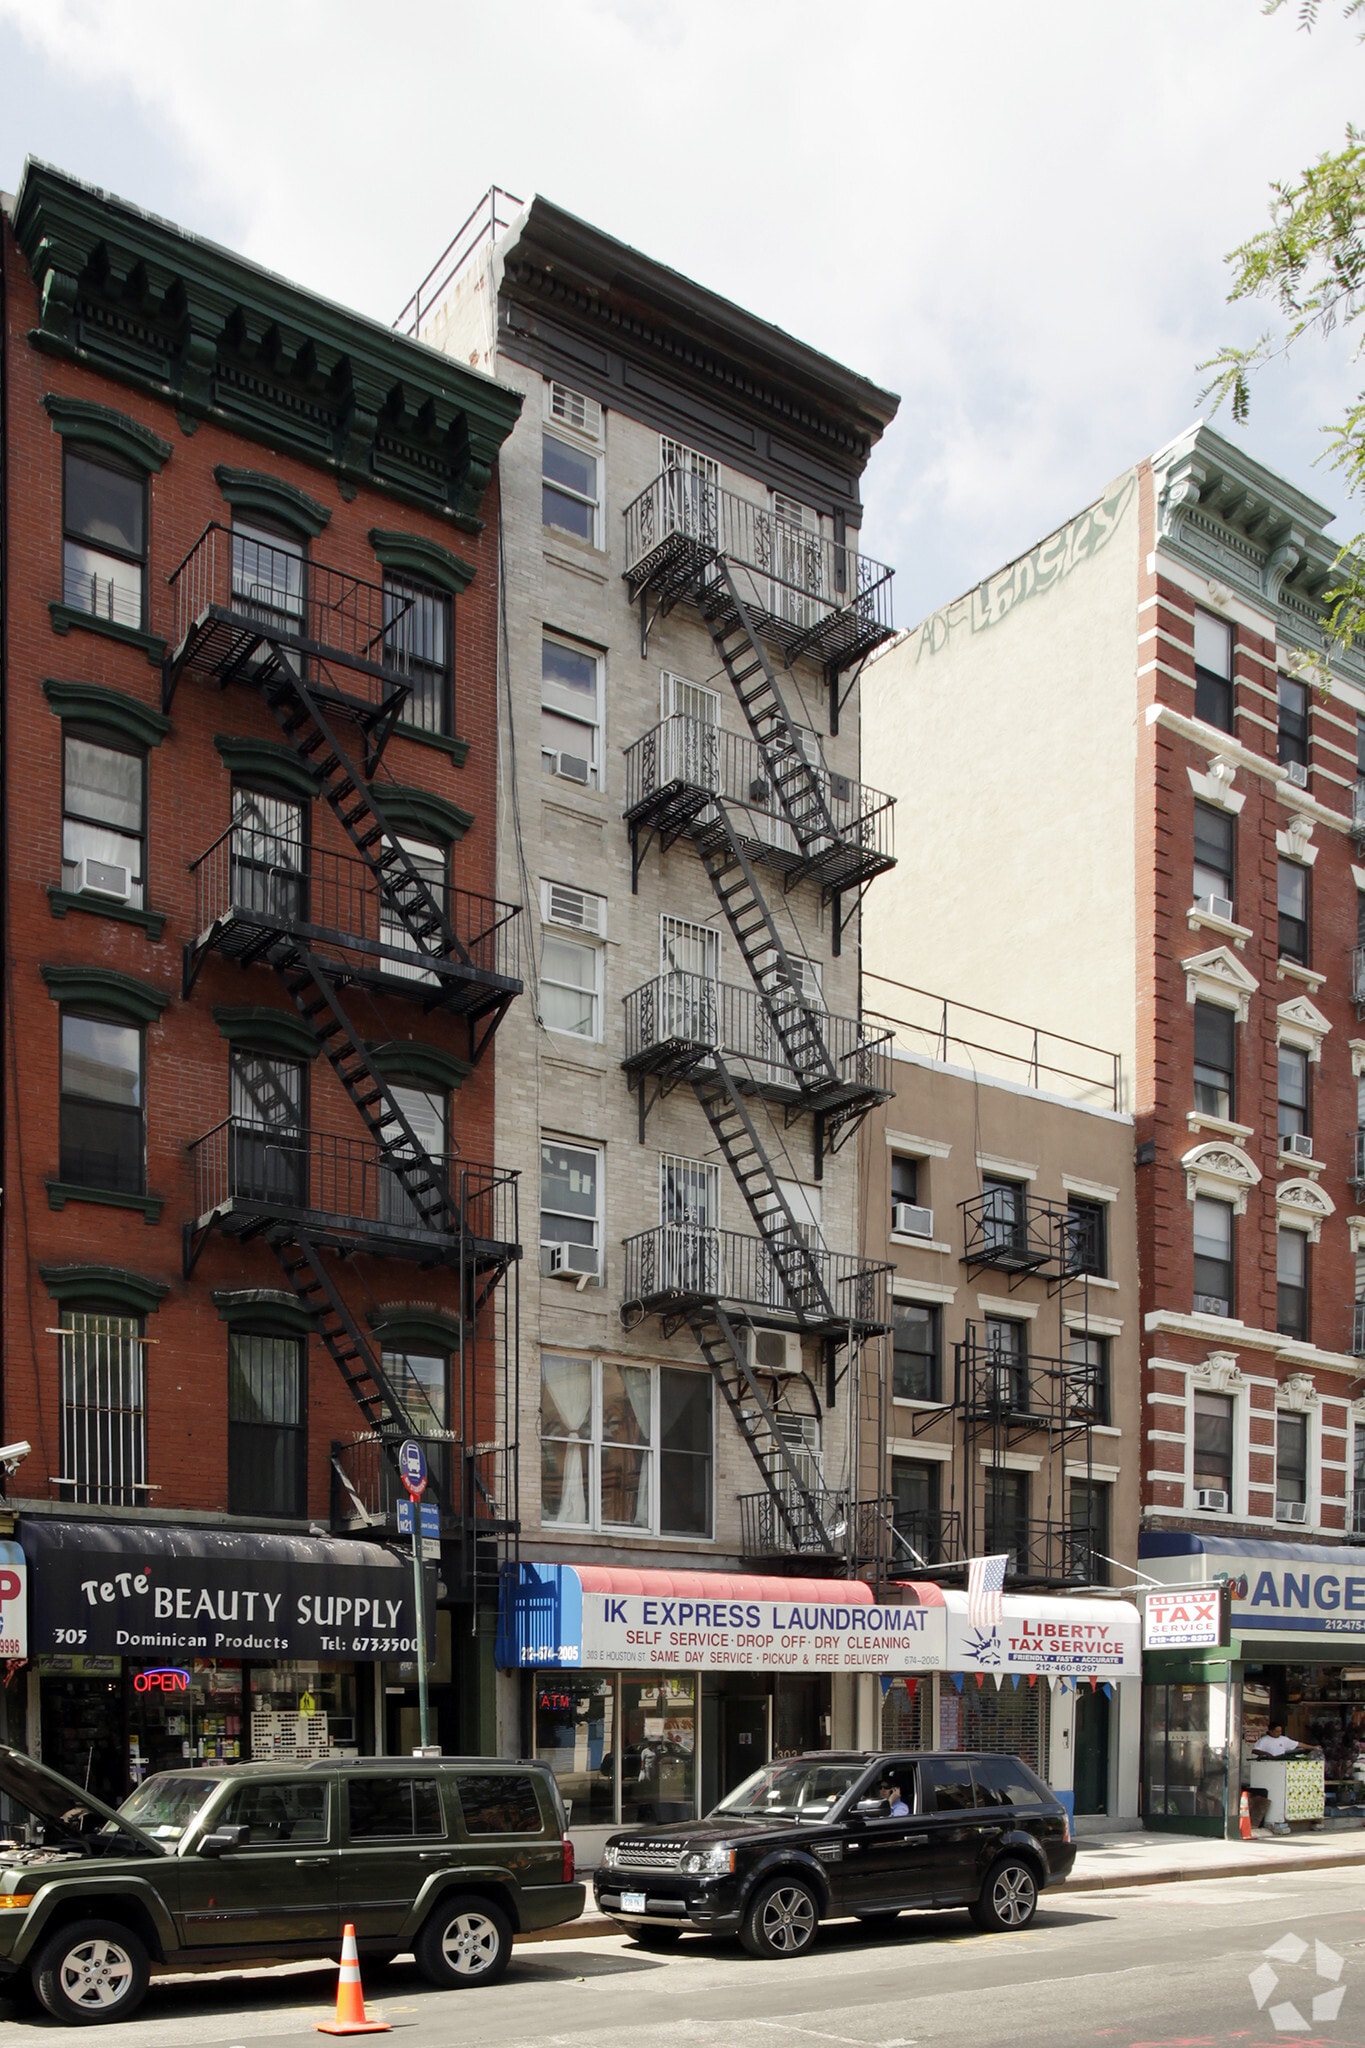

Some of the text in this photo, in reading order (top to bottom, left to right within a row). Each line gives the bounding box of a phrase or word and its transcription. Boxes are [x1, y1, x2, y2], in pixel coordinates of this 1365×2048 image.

[400, 1519, 412, 1532] M21
[1250, 1571, 1365, 1611] ANGE
[1152, 1594, 1211, 1605] LIBERTY
[154, 1587, 282, 1622] BEAUTY
[297, 1594, 403, 1628] SUPPLY
[1149, 1605, 1215, 1624] TAX
[643, 1601, 761, 1629] EXPRESS
[773, 1606, 929, 1631] LAUNDROMAT
[1023, 1620, 1110, 1639] LIBERTY
[1152, 1623, 1213, 1633] SERVICE
[1325, 1619, 1365, 1631] 212-475-
[55, 1628, 87, 1645] 305
[116, 1630, 207, 1648] Dominican
[214, 1632, 289, 1650] Products
[320, 1636, 346, 1650] Tel:
[626, 1630, 911, 1649] SELF SERVICE DROP OFF DRY CLEANING
[1008, 1638, 1124, 1654] TAX SERVICE
[521, 1646, 579, 1661] 212-674-2005
[586, 1650, 598, 1660] 303
[600, 1651, 604, 1660] E
[606, 1651, 636, 1661] HOUSTON
[650, 1650, 889, 1665] SAME DAY SERVICE PICKUP & FREE DELIVERY
[904, 1656, 940, 1665] 674-2005
[1013, 1654, 1119, 1664] FRIENDLY FAST ACCURATE
[133, 1673, 187, 1692] OPEN
[541, 1694, 570, 1708] ATM
